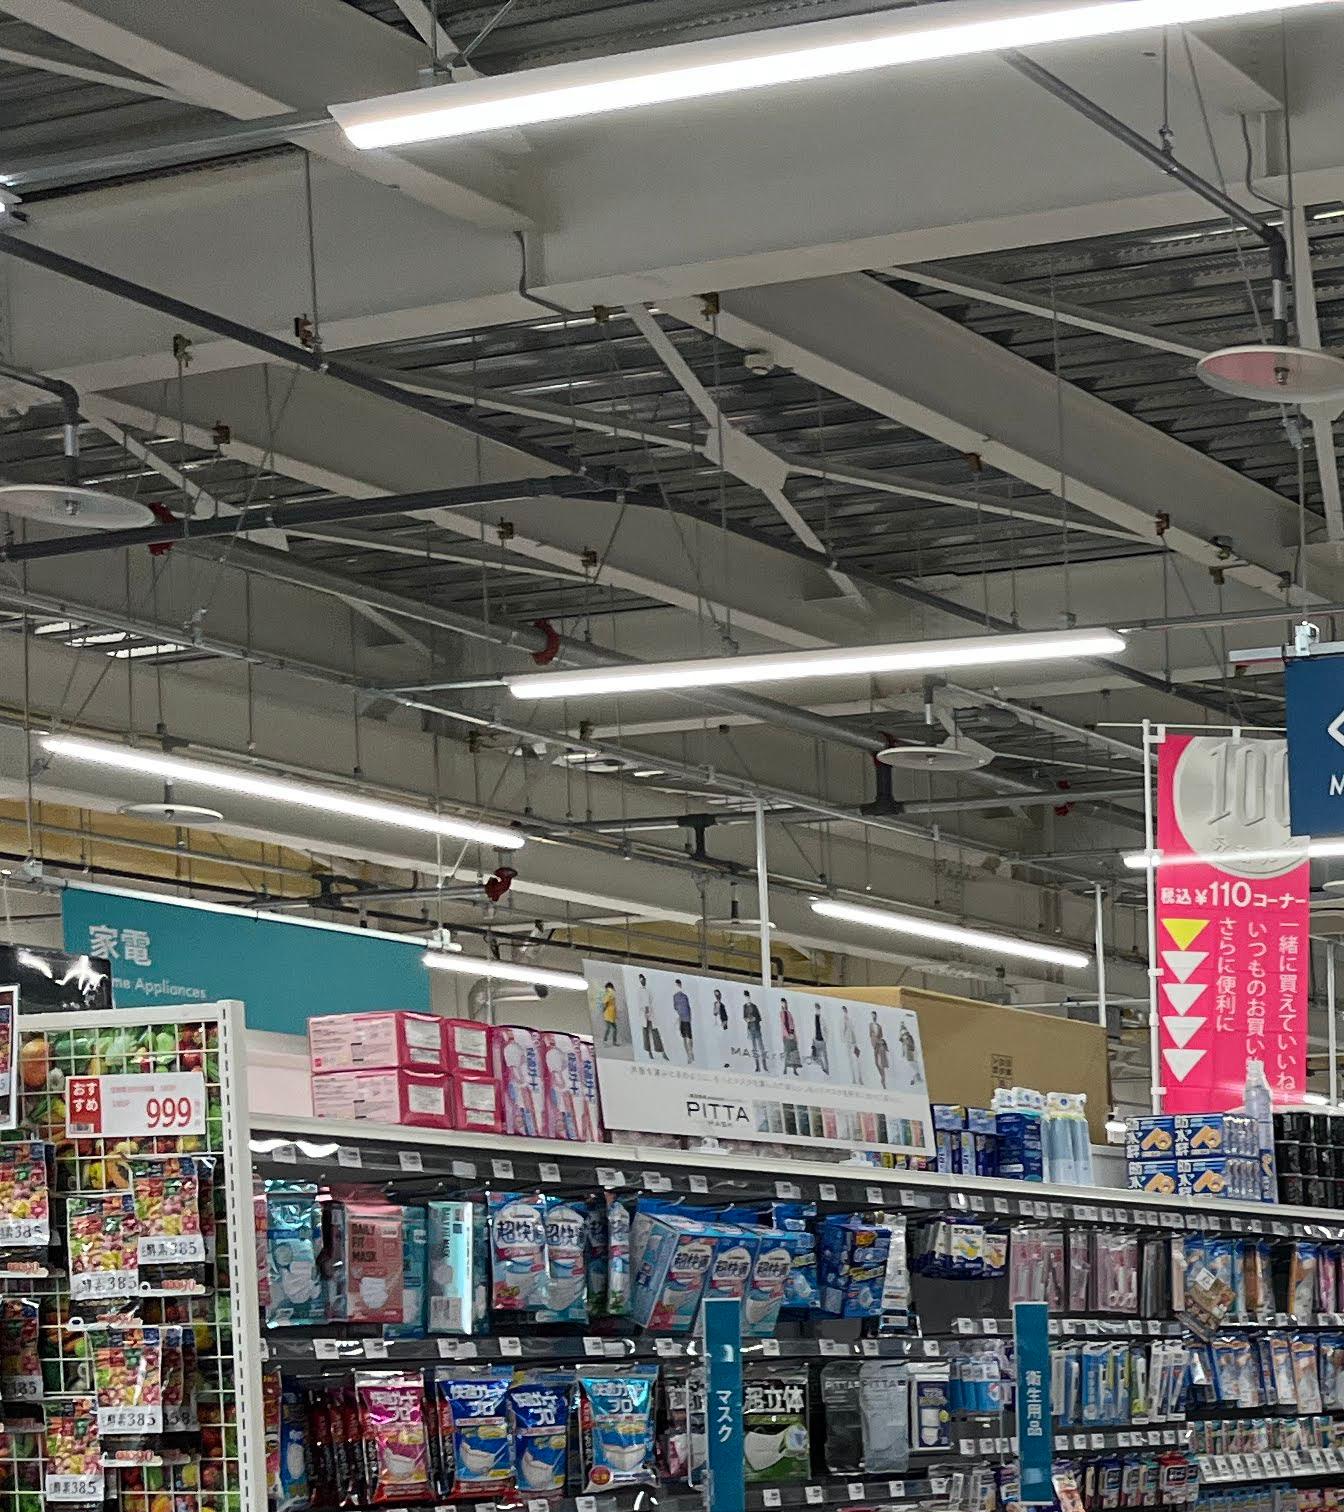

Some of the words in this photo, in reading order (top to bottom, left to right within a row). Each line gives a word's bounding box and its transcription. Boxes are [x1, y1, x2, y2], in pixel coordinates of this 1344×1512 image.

[88, 925, 152, 967] 家電
[134, 977, 208, 1000] Appliances
[1216, 916, 1238, 1032] さらに便利に
[146, 1096, 192, 1129] 999
[687, 1100, 750, 1123] PITTA
[716, 1389, 733, 1443] マスク
[1025, 1370, 1043, 1437] 衛生用品
